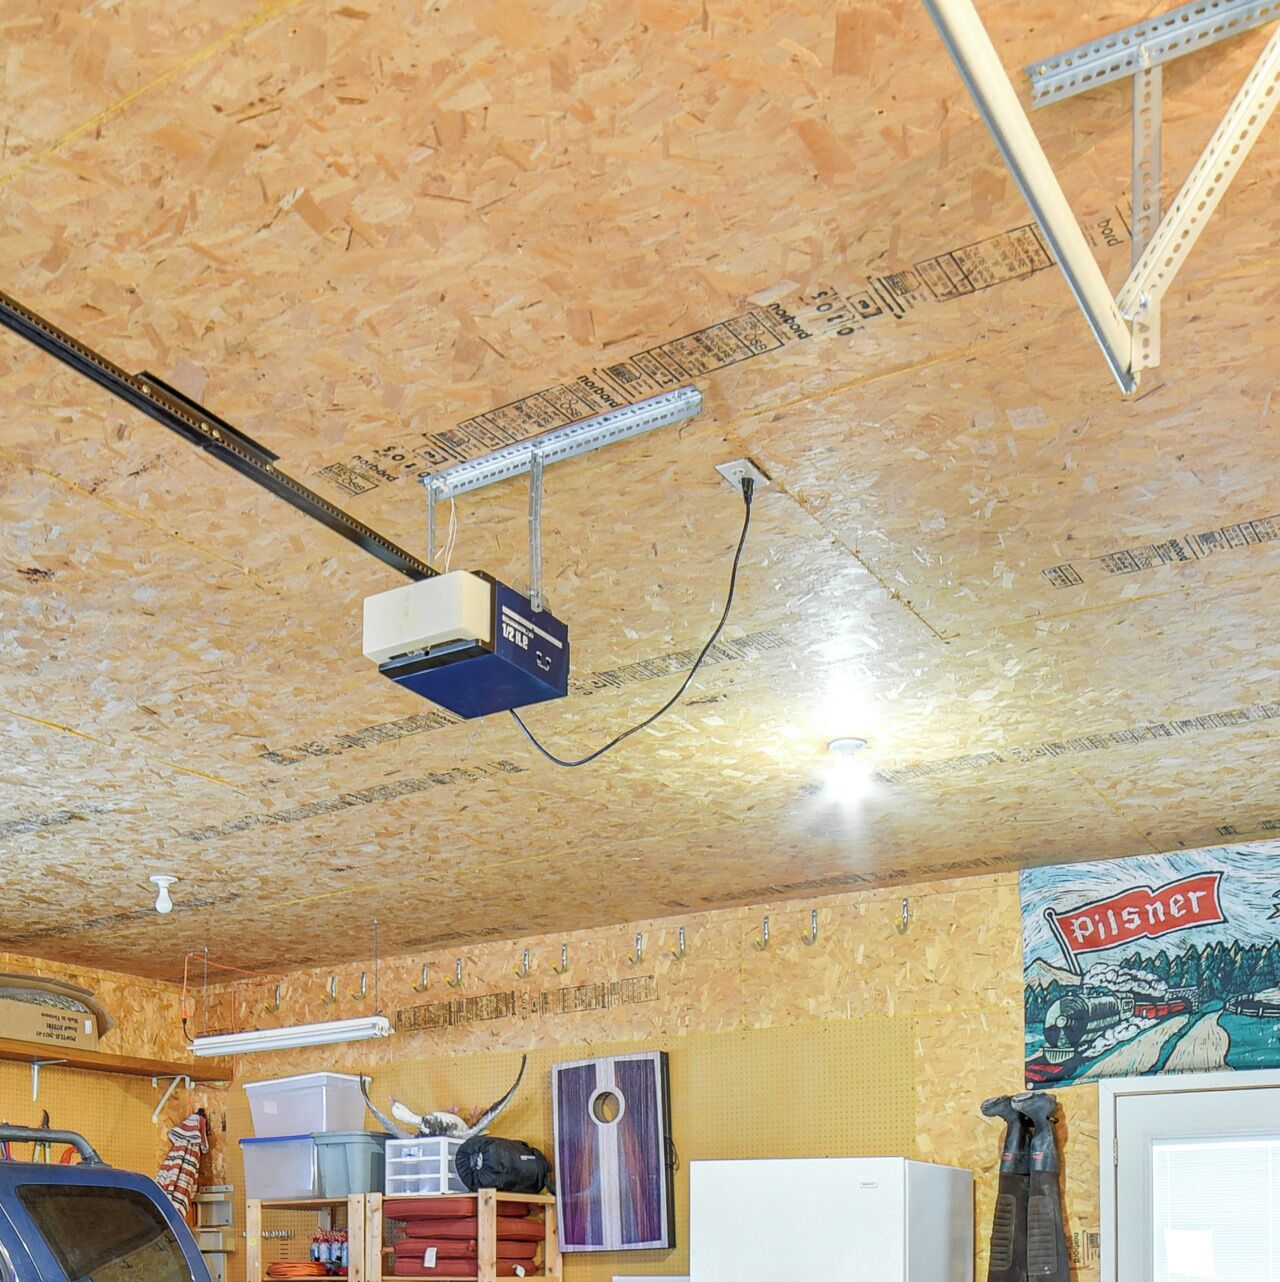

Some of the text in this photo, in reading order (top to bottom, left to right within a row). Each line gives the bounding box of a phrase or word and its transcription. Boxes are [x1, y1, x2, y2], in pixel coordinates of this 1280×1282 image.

[769, 302, 814, 340] norbord
[576, 374, 622, 409] norbord
[351, 455, 398, 483] norbord
[1072, 888, 1208, 944] Pilsner
